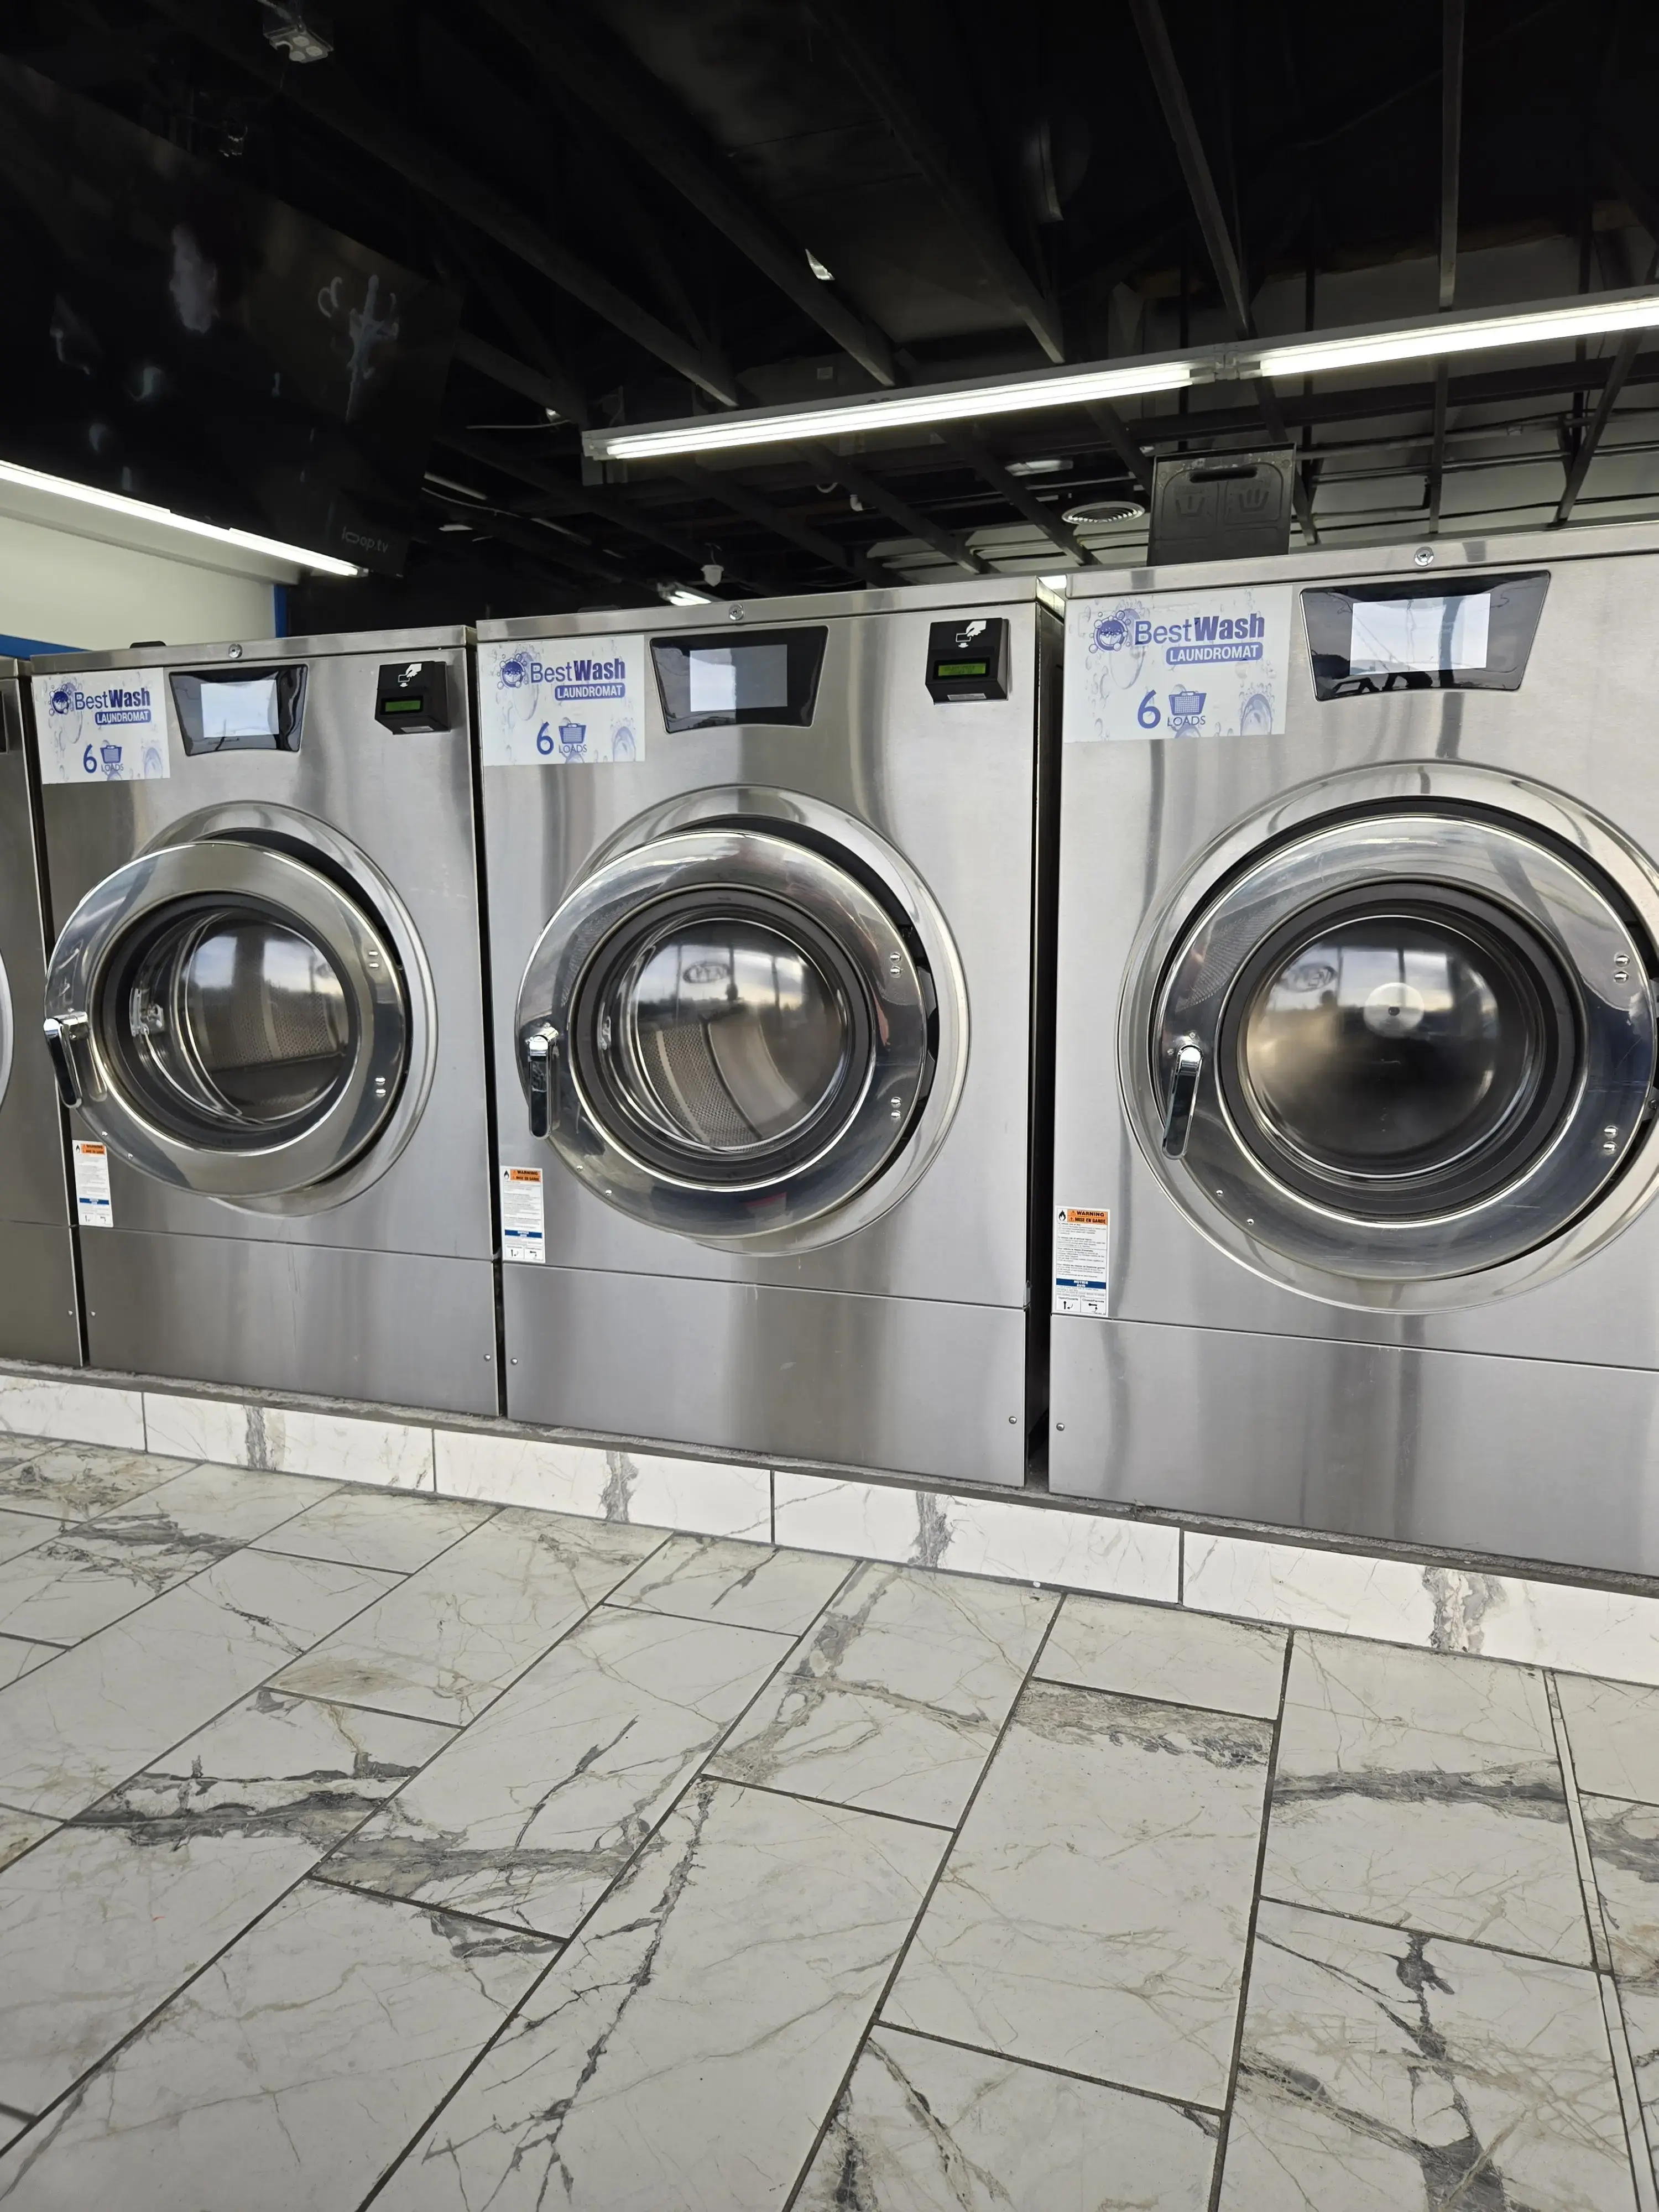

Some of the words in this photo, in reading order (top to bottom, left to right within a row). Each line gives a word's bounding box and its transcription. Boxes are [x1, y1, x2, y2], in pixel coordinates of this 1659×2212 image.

[341, 526, 389, 553] loop.tv
[1134, 613, 1265, 645] BestWash
[1170, 645, 1259, 662] LAUNDROMAT
[530, 658, 625, 683] BestWash
[75, 687, 150, 710] BestWash
[557, 685, 623, 699] LAUNDROMAT
[97, 711, 149, 724] LAUNDROMAT
[1137, 689, 1161, 729] 6
[1167, 716, 1206, 727] LOADS
[536, 721, 554, 755] 6
[559, 744, 587, 753] LOADS
[83, 744, 97, 773] 6
[101, 764, 124, 772] LOADS
